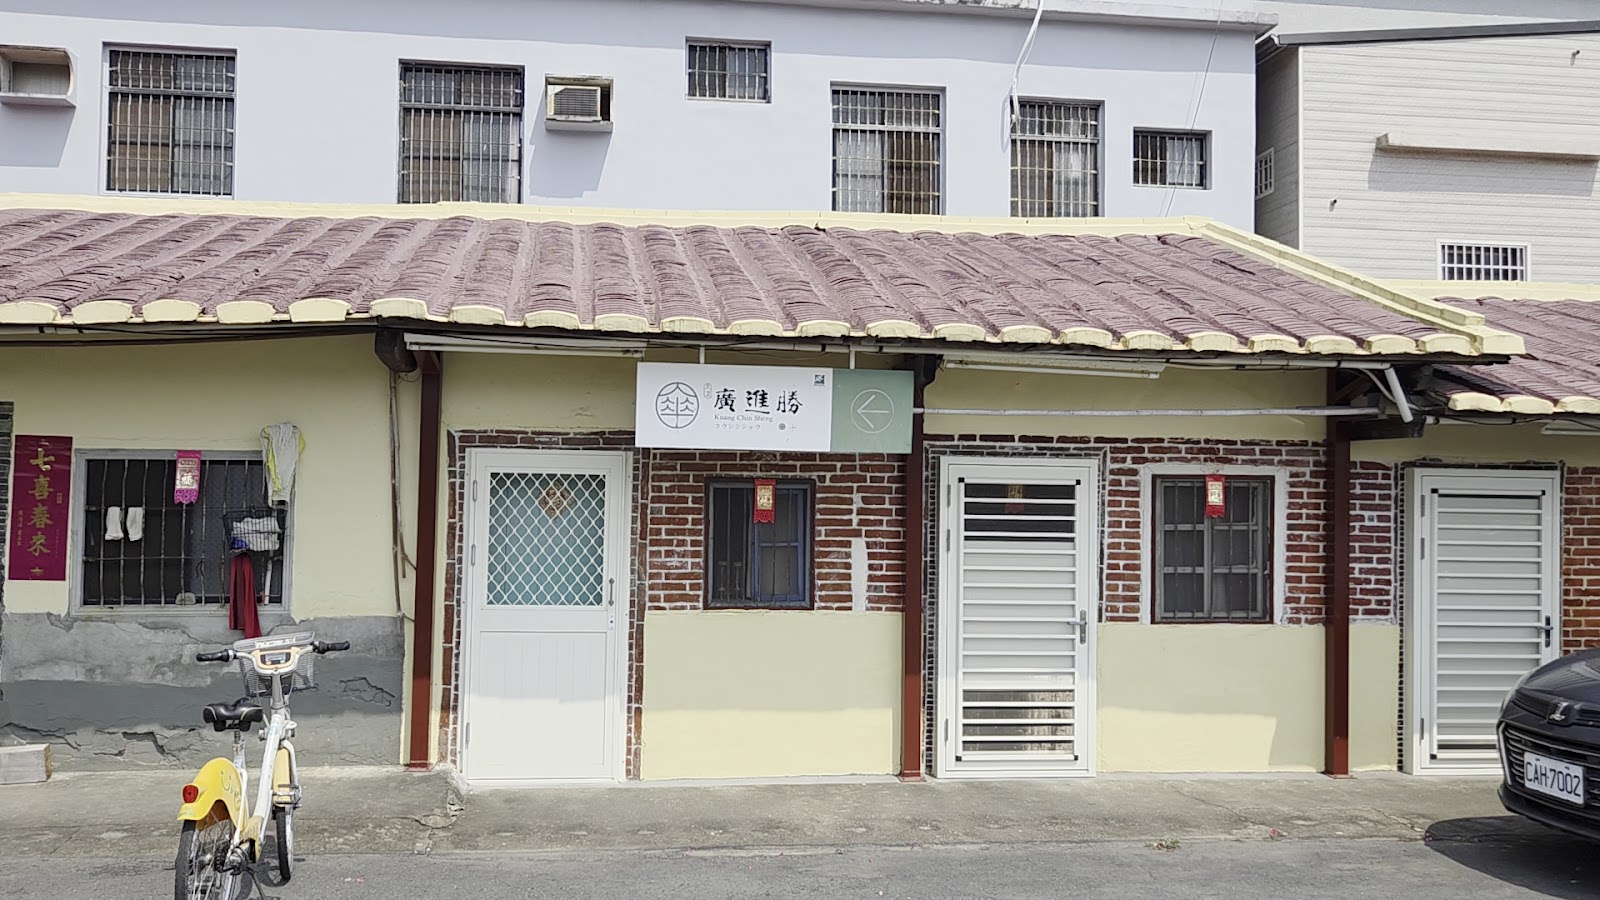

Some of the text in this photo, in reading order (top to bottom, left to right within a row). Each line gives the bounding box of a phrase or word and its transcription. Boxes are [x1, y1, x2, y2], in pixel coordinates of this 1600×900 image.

[714, 388, 803, 414] 廣進勝
[714, 414, 735, 422] Kuang
[753, 415, 773, 423] Sheng
[1526, 761, 1581, 797] CAH-7002
